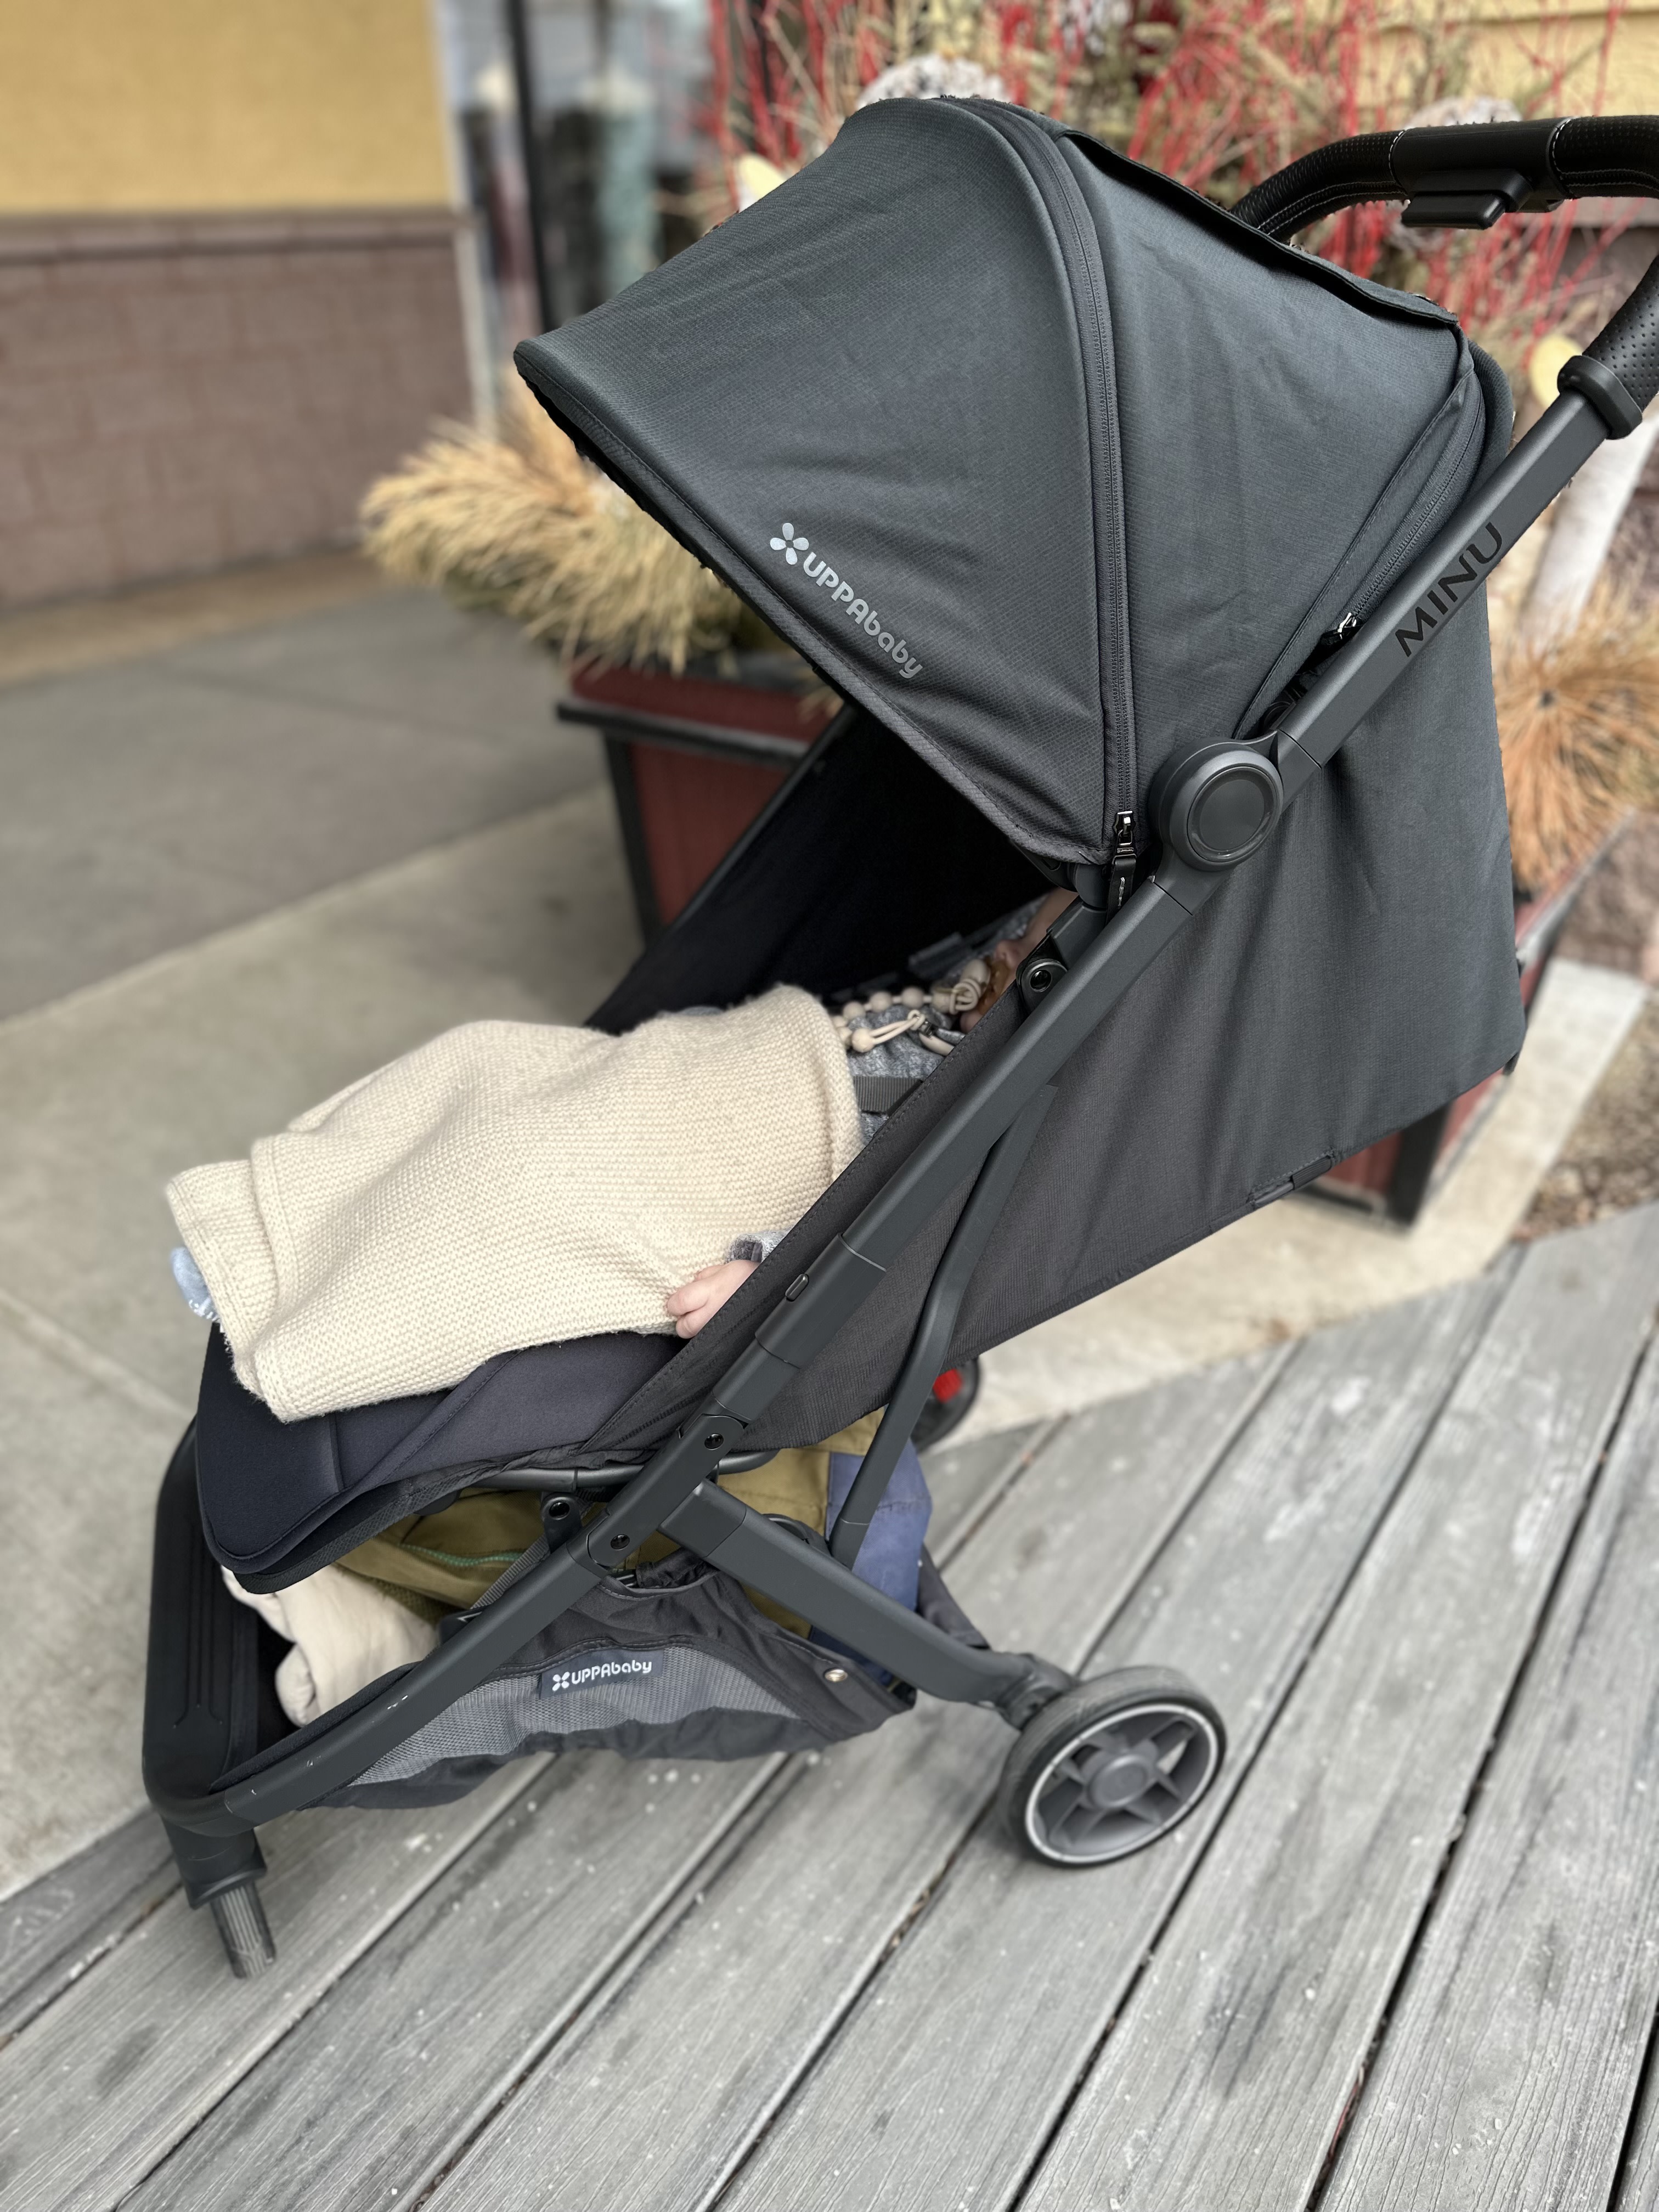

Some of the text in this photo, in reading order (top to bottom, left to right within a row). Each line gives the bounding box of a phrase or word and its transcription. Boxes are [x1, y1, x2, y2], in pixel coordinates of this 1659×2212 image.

[803, 552, 923, 679] UPPAbaby
[1395, 522, 1502, 657] MINU
[572, 1660, 652, 1684] UPPAbaby
